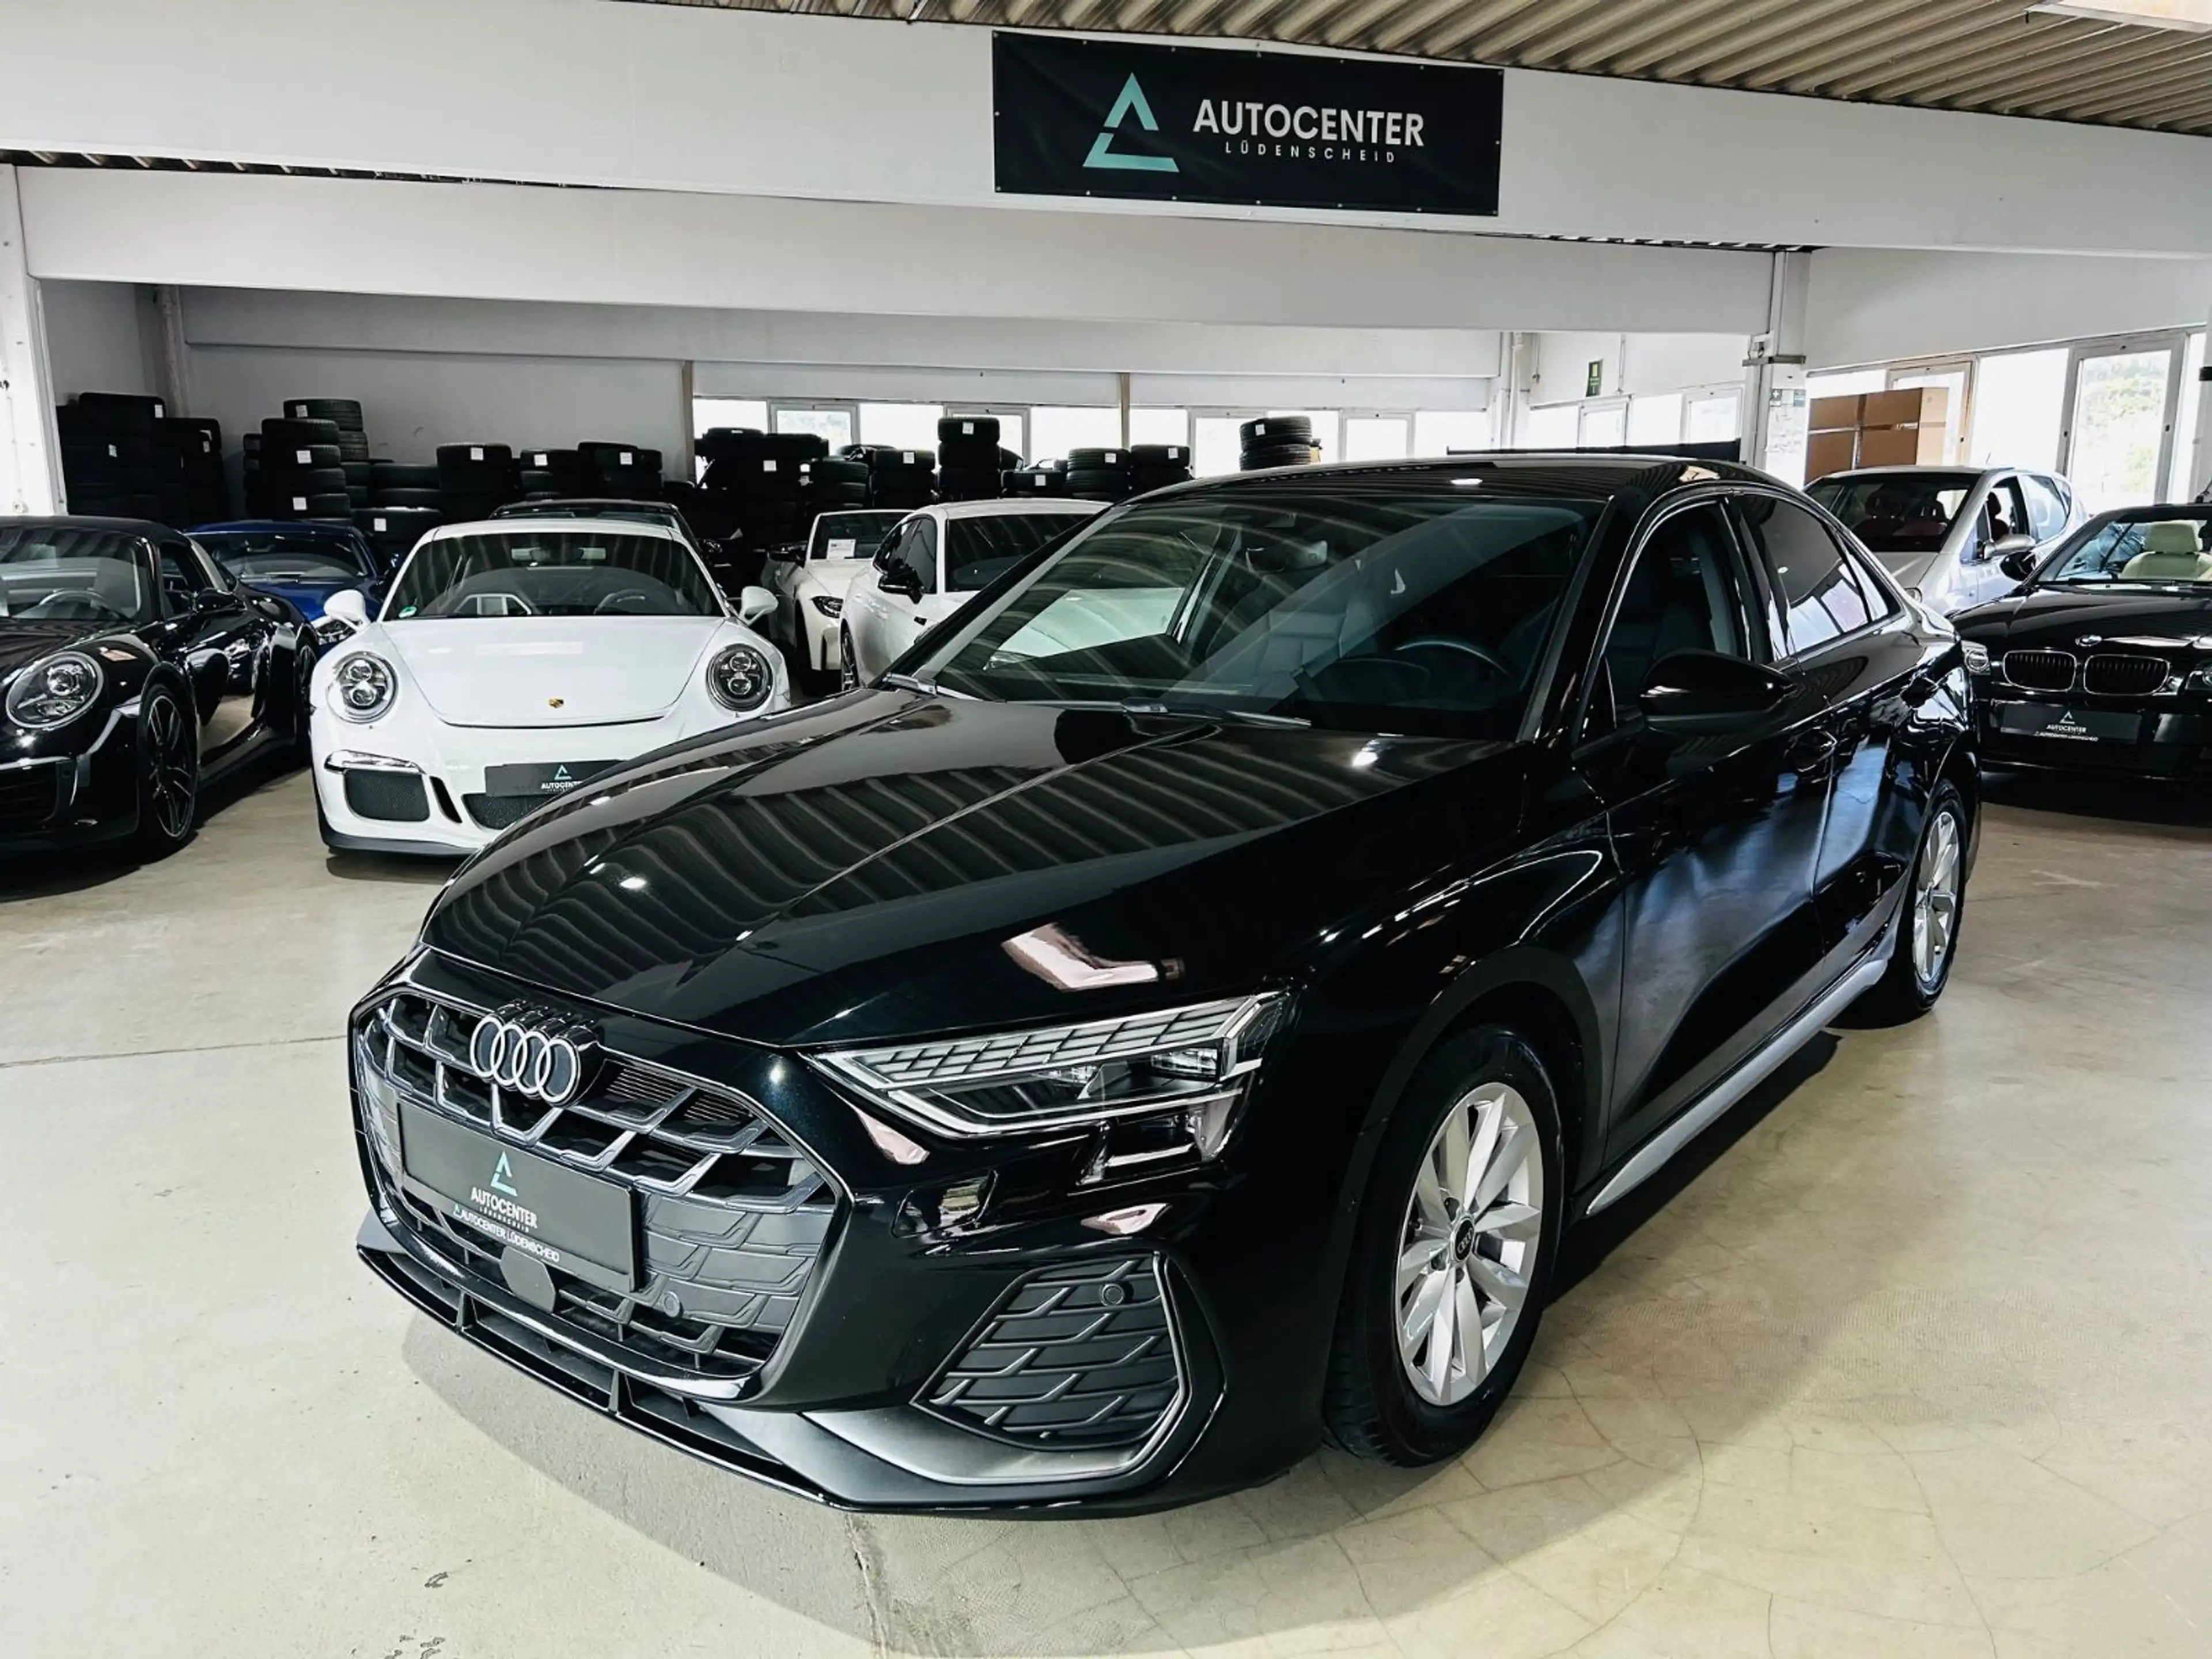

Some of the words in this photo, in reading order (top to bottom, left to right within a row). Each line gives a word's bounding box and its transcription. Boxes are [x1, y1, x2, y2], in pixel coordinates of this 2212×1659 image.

[1192, 99, 1425, 146] AUTOCENTER
[1225, 139, 1395, 163] LÜDENSCHEID
[471, 1186, 538, 1229] AUTOCENTER
